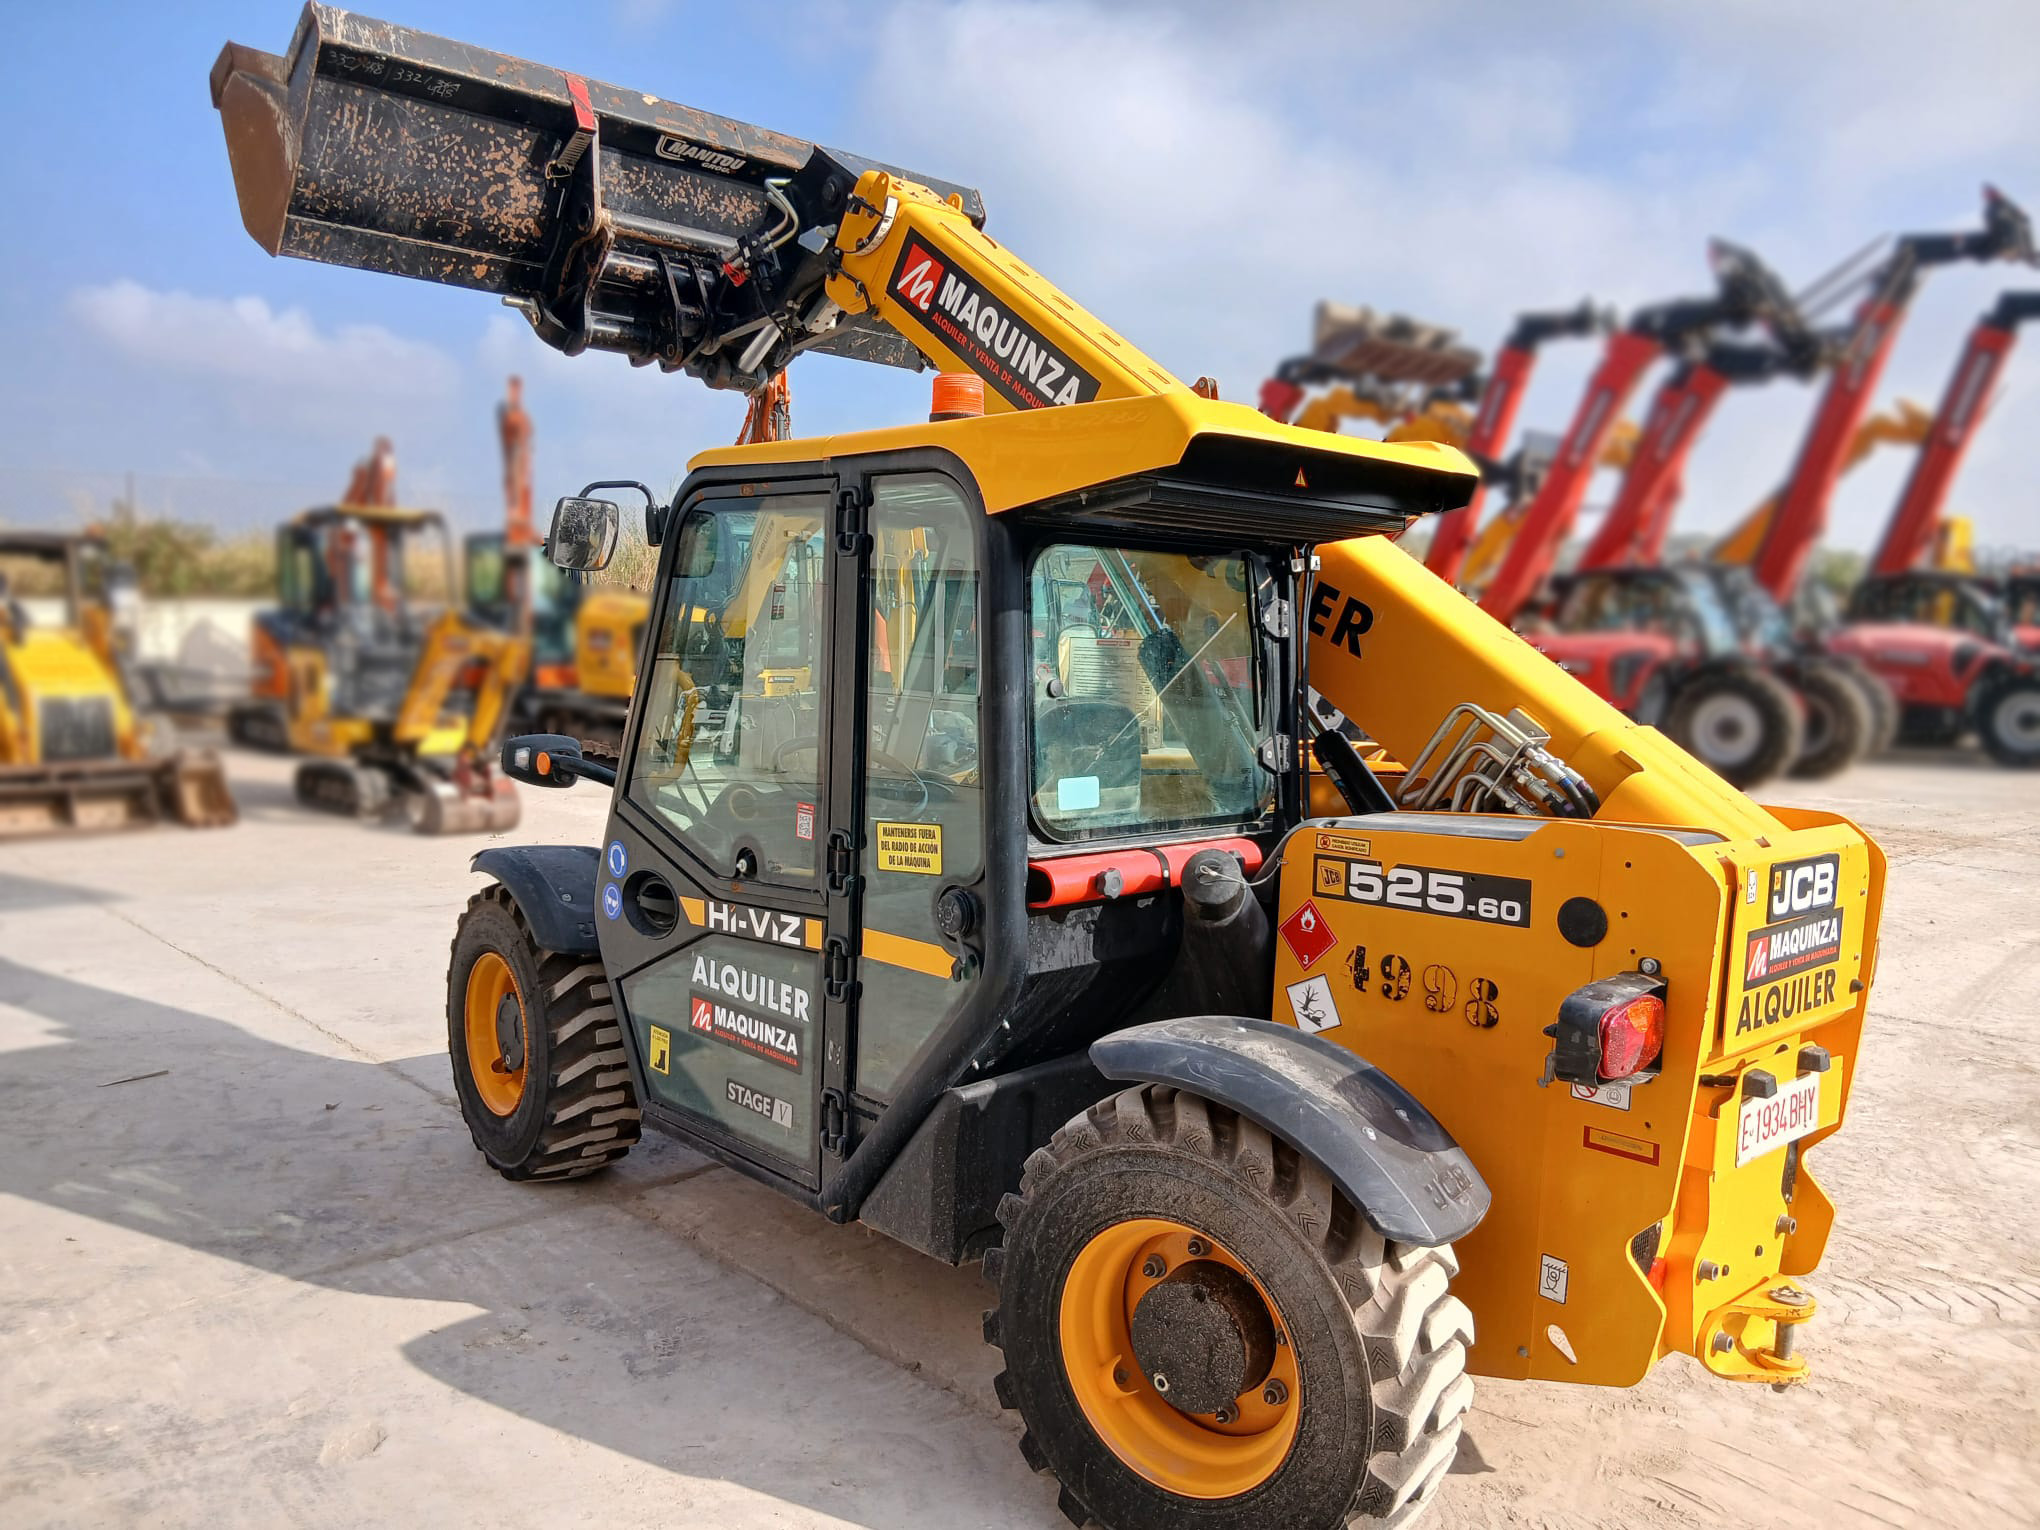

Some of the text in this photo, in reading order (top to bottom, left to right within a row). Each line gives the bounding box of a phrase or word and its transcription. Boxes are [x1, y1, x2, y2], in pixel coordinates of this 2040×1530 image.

[667, 141, 747, 170] MANITOU
[932, 312, 967, 348] ALQUILER
[968, 341, 975, 352] Y
[975, 347, 1001, 376] VENTA
[1001, 369, 1013, 385] DE
[938, 272, 1081, 406] MAQUINZA
[1308, 580, 1374, 660] ER
[880, 840, 890, 851] DEL
[891, 841, 909, 852] RADIO
[910, 842, 917, 852] DE
[882, 826, 937, 840] MANTENERSE FUERA
[889, 855, 896, 866] DE
[897, 855, 904, 866] LA
[1323, 862, 1522, 922] JCB 525-60
[1772, 862, 1835, 916] JCB
[1302, 954, 1309, 965] 3
[1769, 918, 1839, 961] MAQUINZA
[691, 955, 810, 1023] ALQUILER
[1340, 944, 1500, 1029] 4998
[1735, 968, 1836, 1036] ALQUILER
[714, 1005, 798, 1055] MAQUINZA
[727, 1082, 789, 1122] STAGE V
[1741, 1112, 1752, 1153] E
